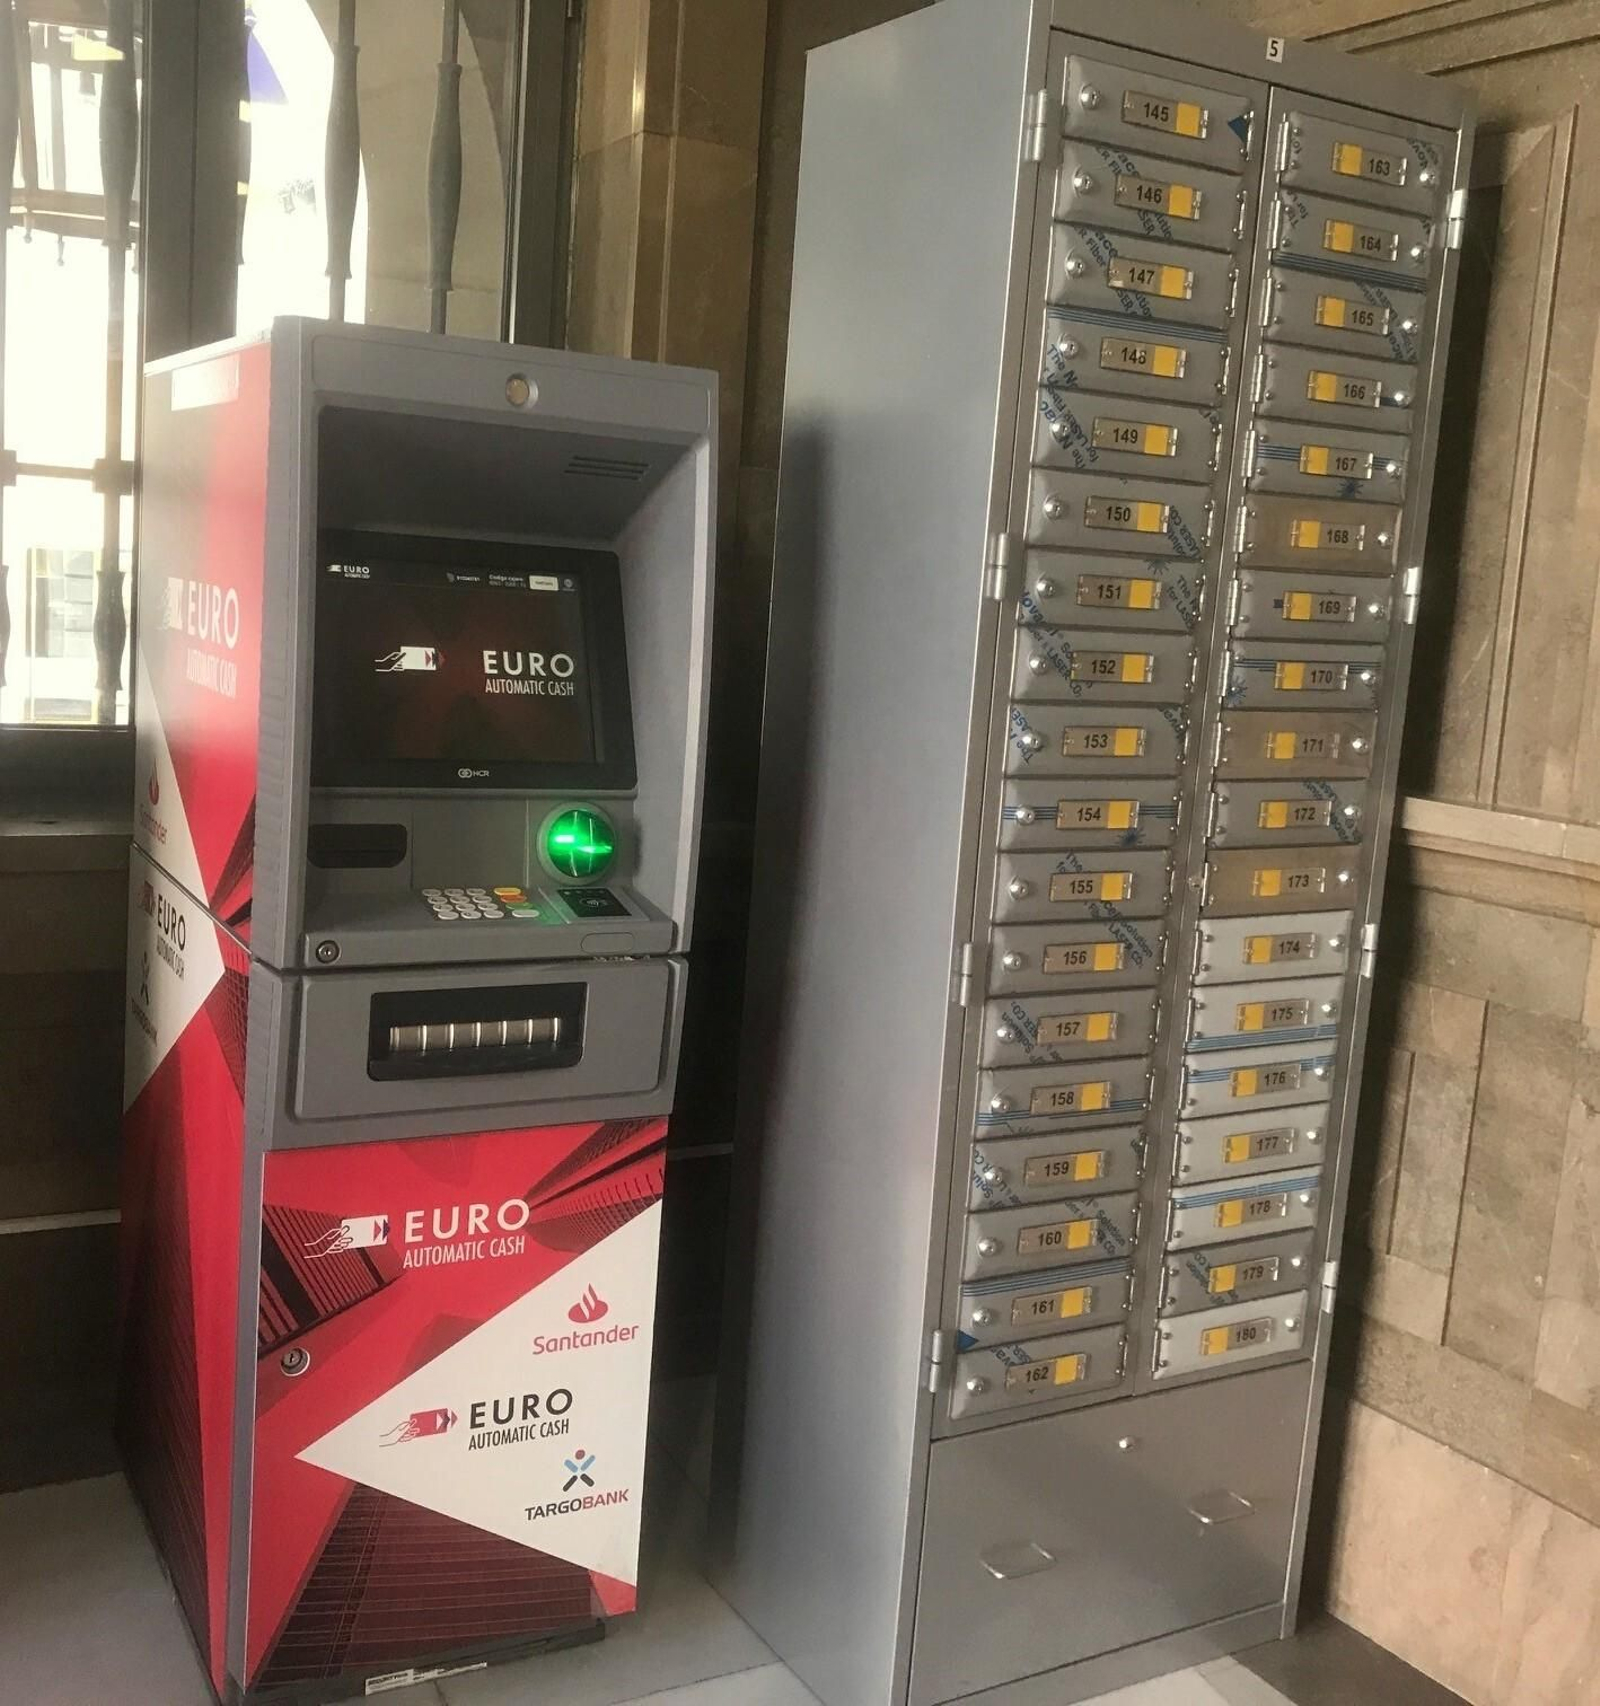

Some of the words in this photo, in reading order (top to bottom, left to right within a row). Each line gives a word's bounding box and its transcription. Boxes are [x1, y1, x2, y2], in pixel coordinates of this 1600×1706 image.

[1269, 40, 1279, 58] 5
[1144, 102, 1169, 122] 145
[1369, 158, 1390, 176] 163
[1136, 184, 1162, 203] 146
[1360, 235, 1382, 251] 164
[1129, 267, 1155, 285] 147
[1351, 309, 1374, 327] 165
[1343, 383, 1366, 400] 166
[1113, 427, 1138, 444] 149
[1335, 456, 1358, 471] 167
[1106, 506, 1131, 522] 150
[1326, 529, 1349, 544] 168
[343, 565, 370, 575] EURO
[1097, 584, 1122, 600] 151
[187, 580, 240, 650] EURO
[1318, 600, 1341, 615] 169
[483, 650, 574, 677] EURO
[1091, 659, 1117, 675] 152
[219, 659, 237, 699] CASH
[1310, 670, 1333, 684] 170
[485, 678, 546, 695] AUTOMATIC
[547, 681, 574, 696] CASH
[1083, 734, 1109, 749] 153
[1302, 738, 1324, 752] 171
[1077, 807, 1102, 822] 154
[1294, 807, 1316, 821] 172
[1069, 880, 1094, 894] 155
[1287, 874, 1310, 888] 173
[157, 893, 186, 951] EURO
[1278, 940, 1300, 955] 174
[1063, 951, 1087, 965] 156
[1271, 1006, 1293, 1021] 175
[1056, 1021, 1081, 1037] 157
[1264, 1071, 1286, 1087] 176
[1050, 1091, 1075, 1107] 158
[1256, 1136, 1279, 1151] 177
[1044, 1161, 1069, 1177] 159
[1249, 1200, 1272, 1215] 178
[404, 1198, 530, 1244] EURO
[1038, 1231, 1062, 1246] 160
[403, 1240, 486, 1269] AUTOMATIC
[490, 1235, 525, 1257] CASH
[1242, 1265, 1264, 1280] 179
[1031, 1300, 1055, 1316] 161
[532, 1324, 640, 1355] Santander
[1236, 1327, 1257, 1342] 180
[1025, 1366, 1049, 1383] 162
[469, 1388, 574, 1429] EURO
[468, 1422, 536, 1451] AUTOMATIC
[539, 1418, 570, 1439] CASH
[525, 1489, 630, 1521] TARGOBANK
